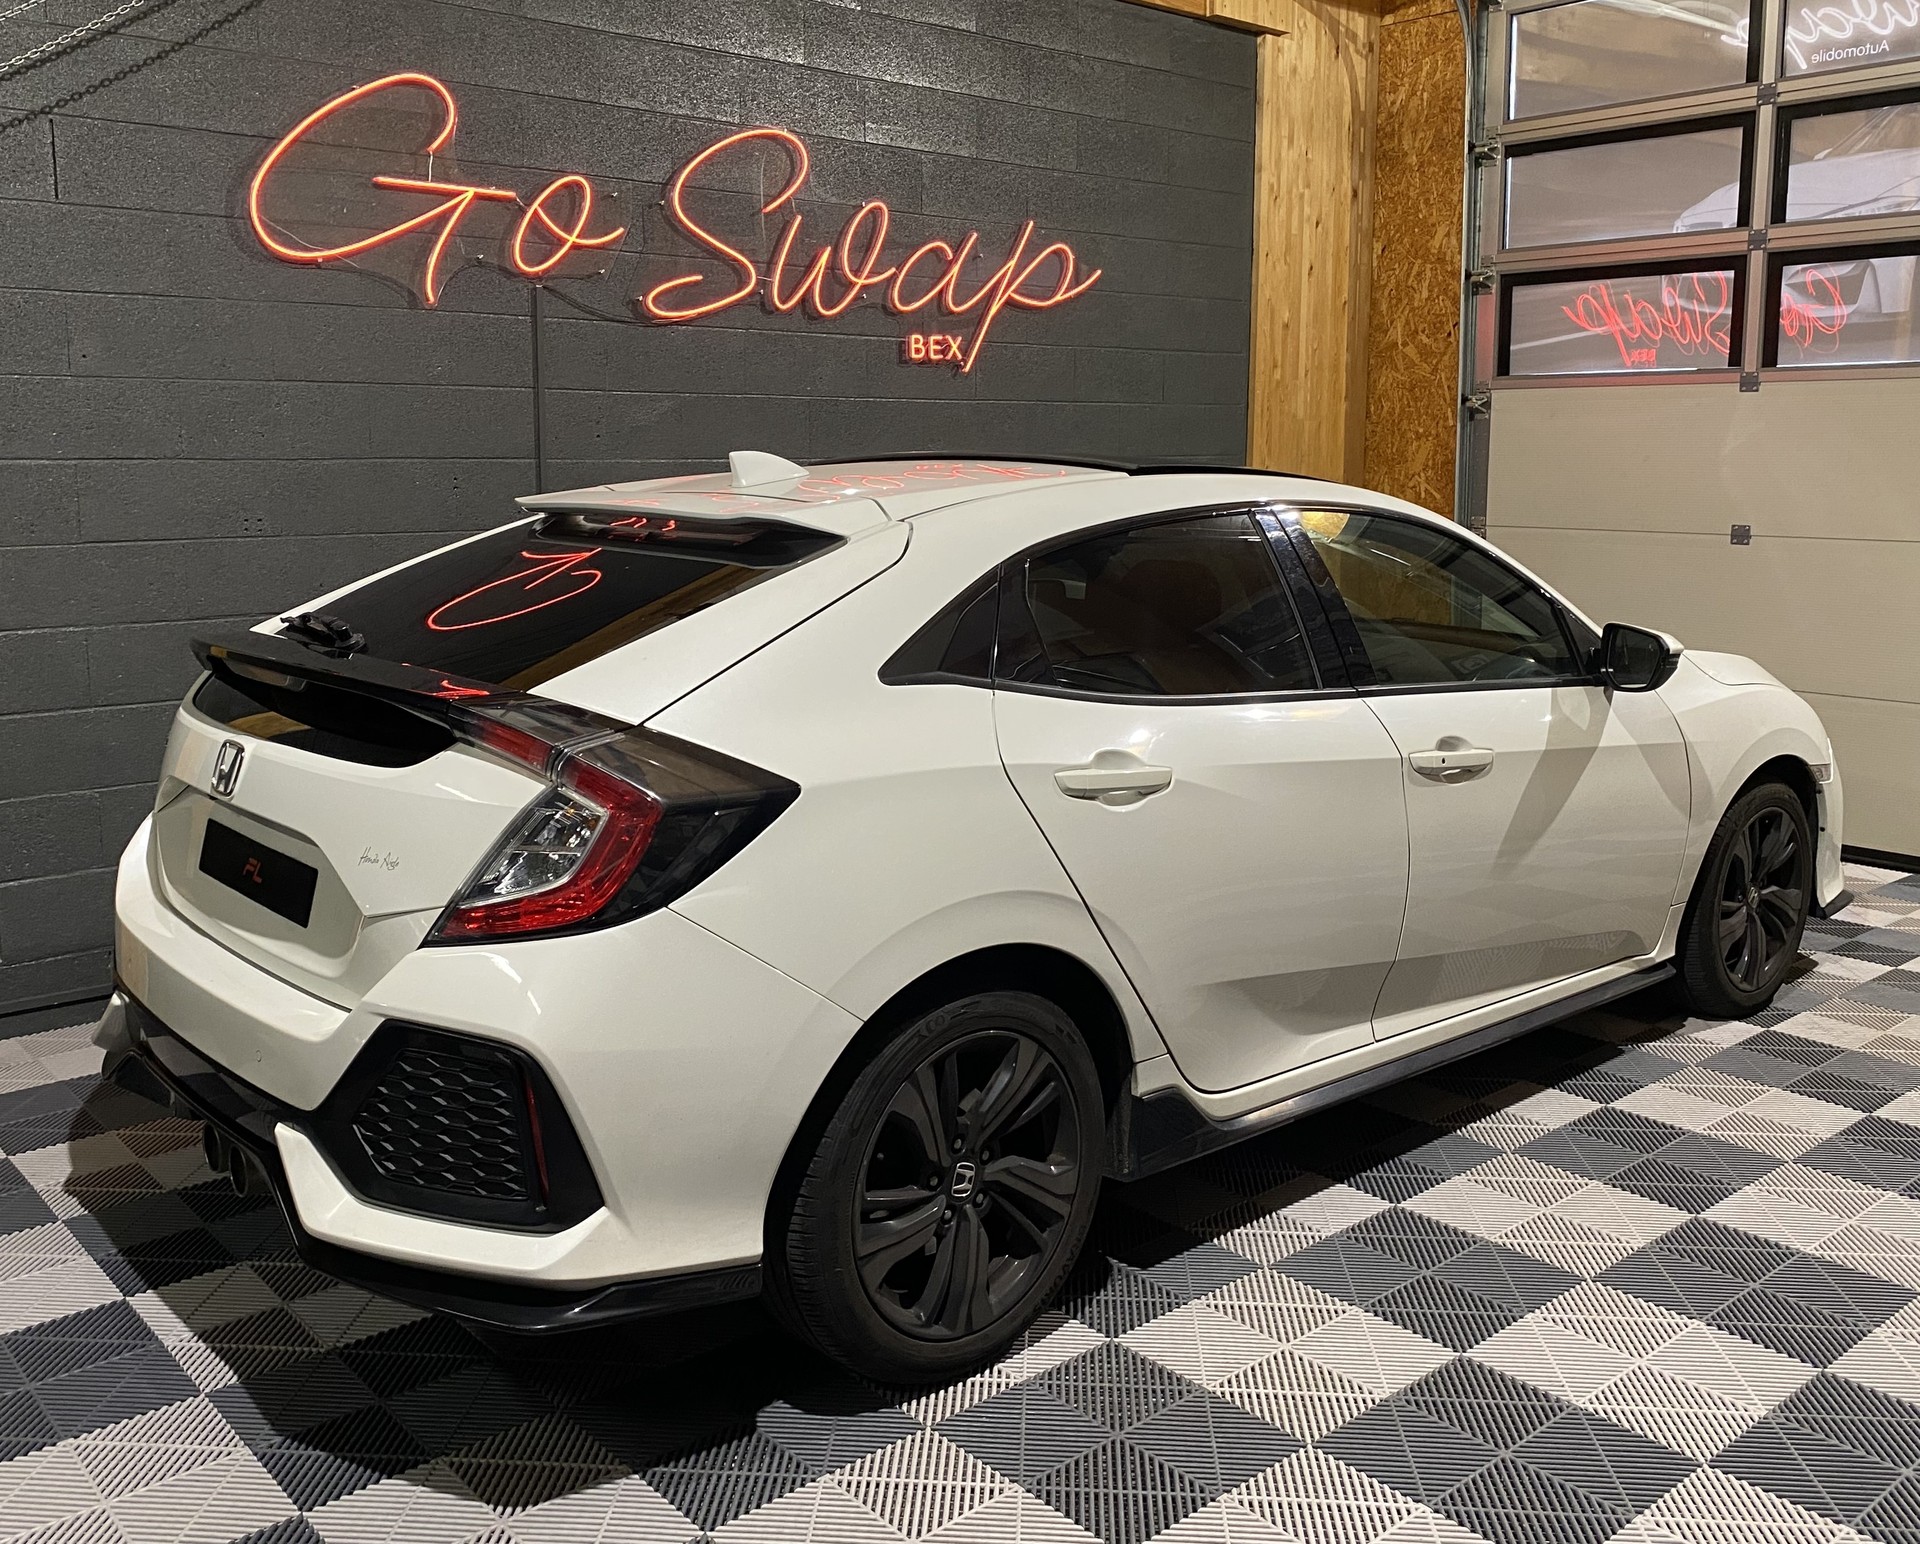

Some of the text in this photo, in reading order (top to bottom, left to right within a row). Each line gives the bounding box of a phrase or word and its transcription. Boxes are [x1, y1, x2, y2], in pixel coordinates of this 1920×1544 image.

[248, 72, 1103, 373] Go Swap
[908, 333, 963, 360] BEX
